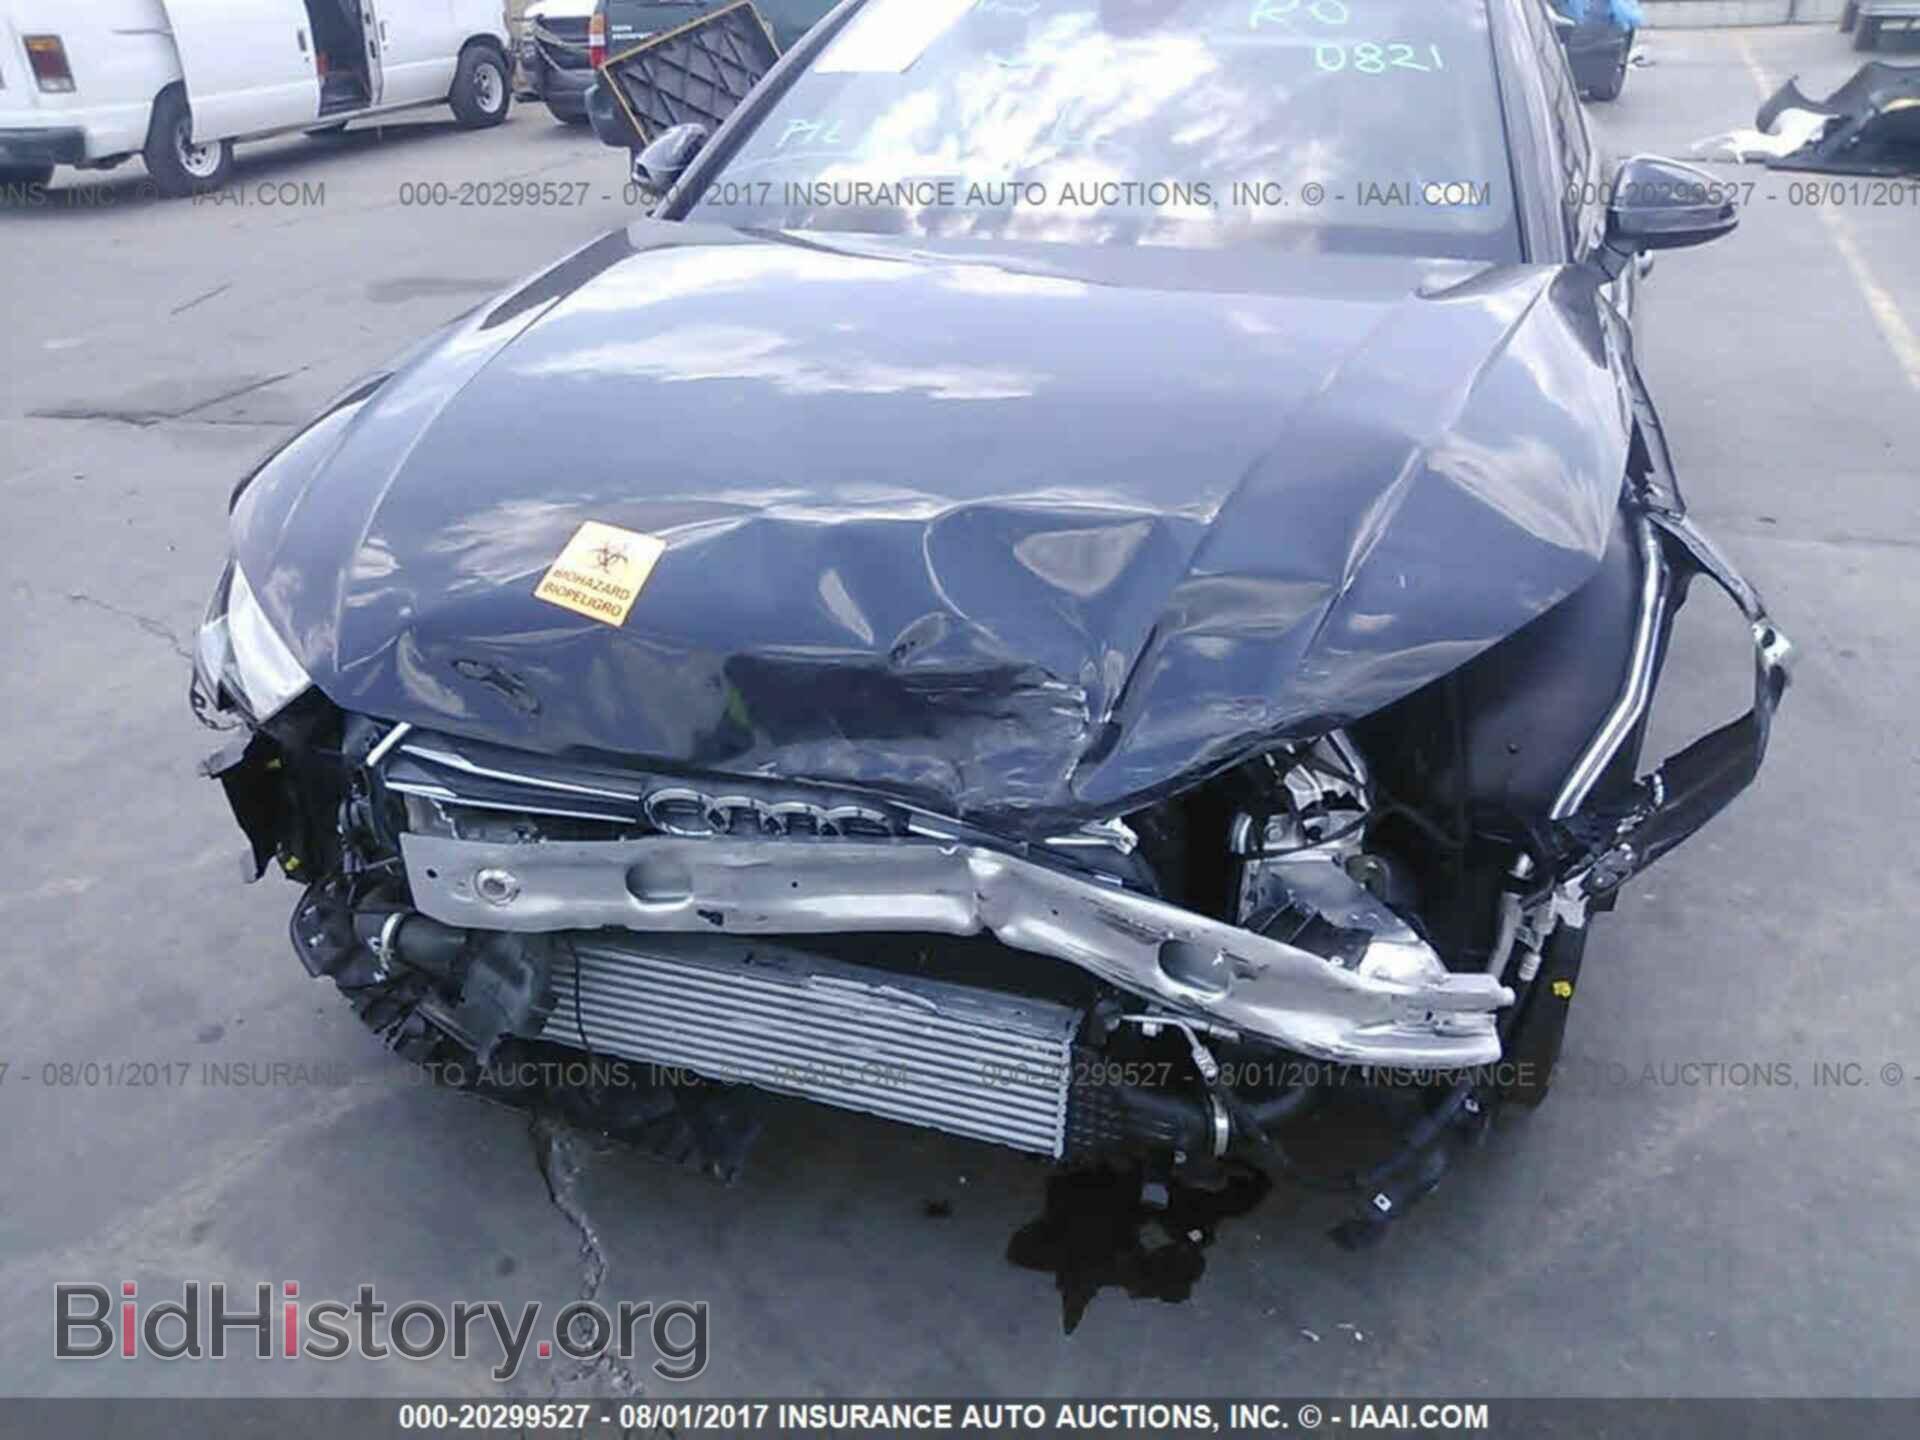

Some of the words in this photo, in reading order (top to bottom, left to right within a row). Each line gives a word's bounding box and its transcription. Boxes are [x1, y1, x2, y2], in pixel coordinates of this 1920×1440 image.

[1315, 42, 1443, 73] 0821
[543, 581, 623, 618] BIOPELIGRO
[552, 569, 631, 602] BIOHAZARD
